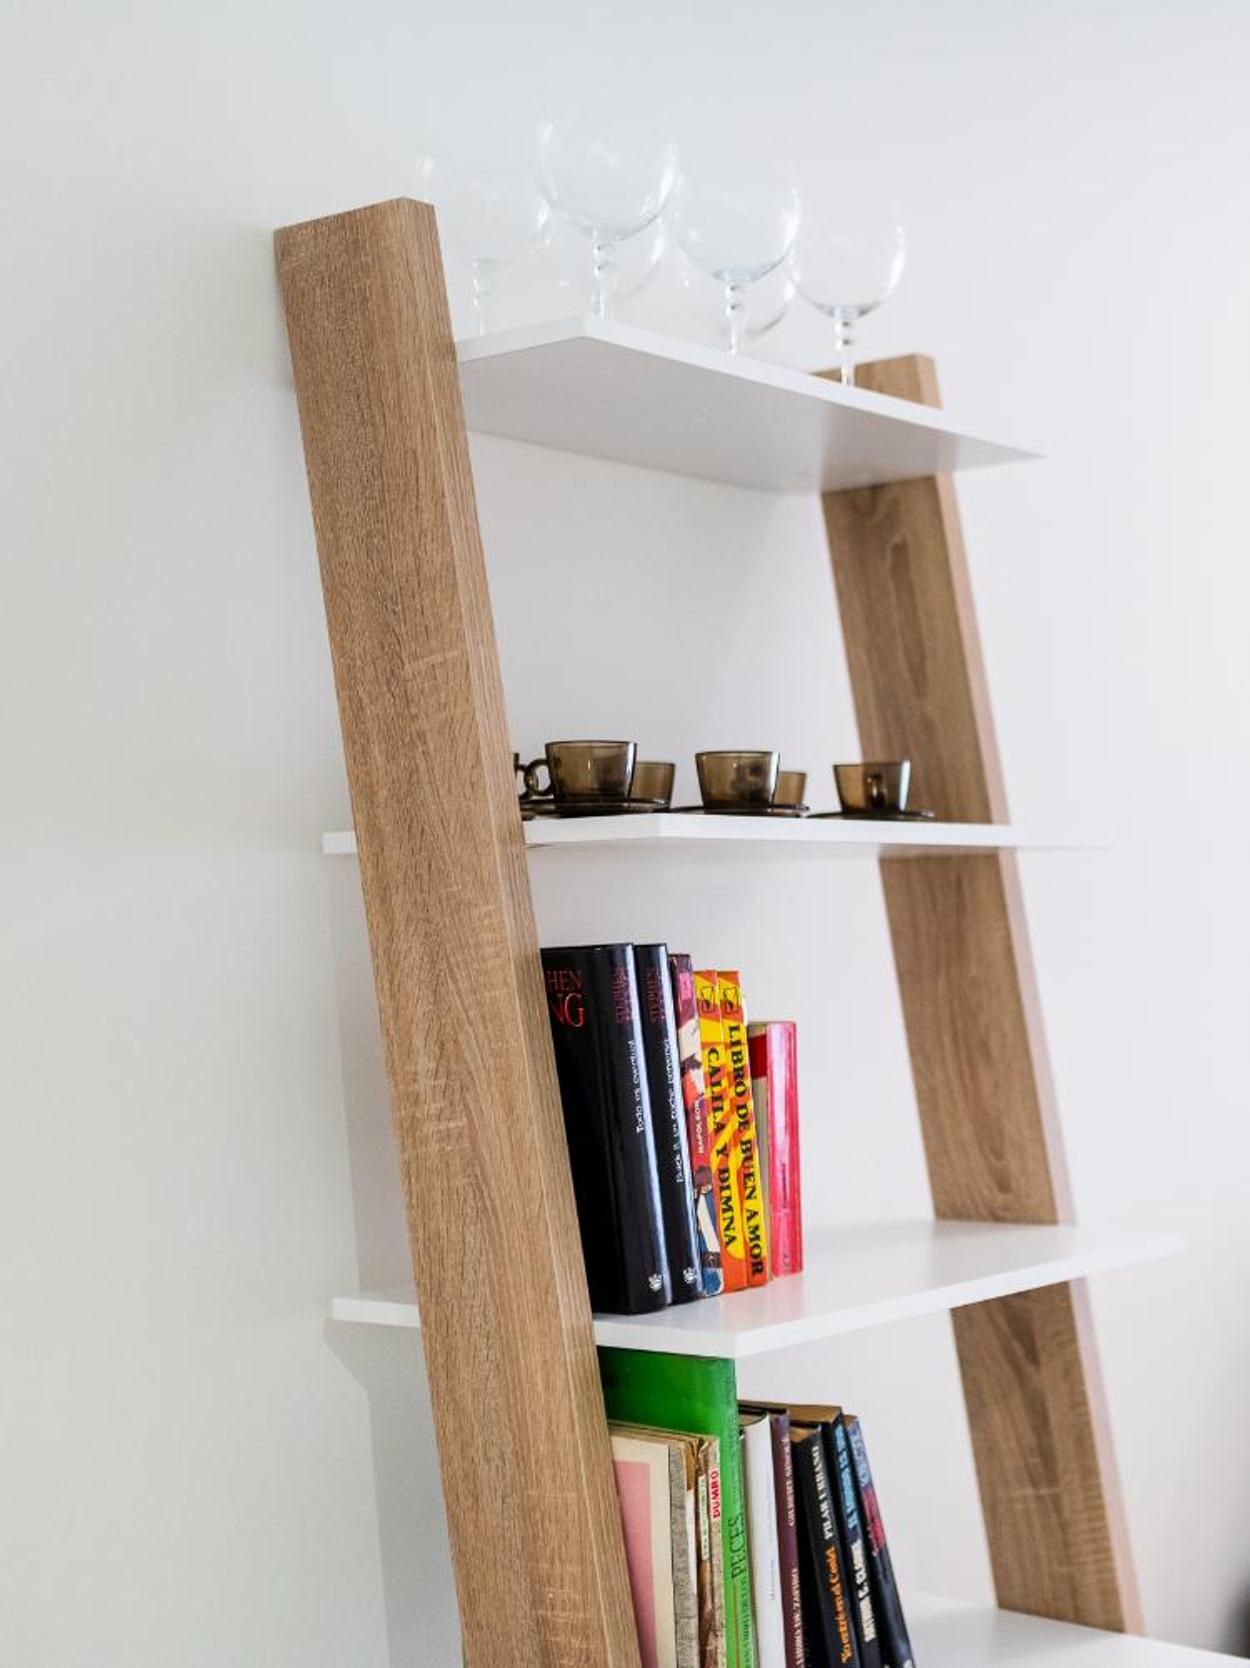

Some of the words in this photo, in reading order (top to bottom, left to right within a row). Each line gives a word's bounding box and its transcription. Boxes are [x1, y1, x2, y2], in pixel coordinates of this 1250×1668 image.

[707, 1047, 726, 1135] CALILA
[728, 1025, 748, 1097] LIBRO
[635, 1105, 644, 1134] Todo
[716, 1142, 728, 1157] Y
[736, 1103, 750, 1133] DE
[741, 1139, 757, 1200] BUEN
[718, 1167, 737, 1245] DIMNA
[746, 1208, 764, 1276] AMOR
[728, 1511, 748, 1579] PECES
[820, 1500, 833, 1540] PILAR
